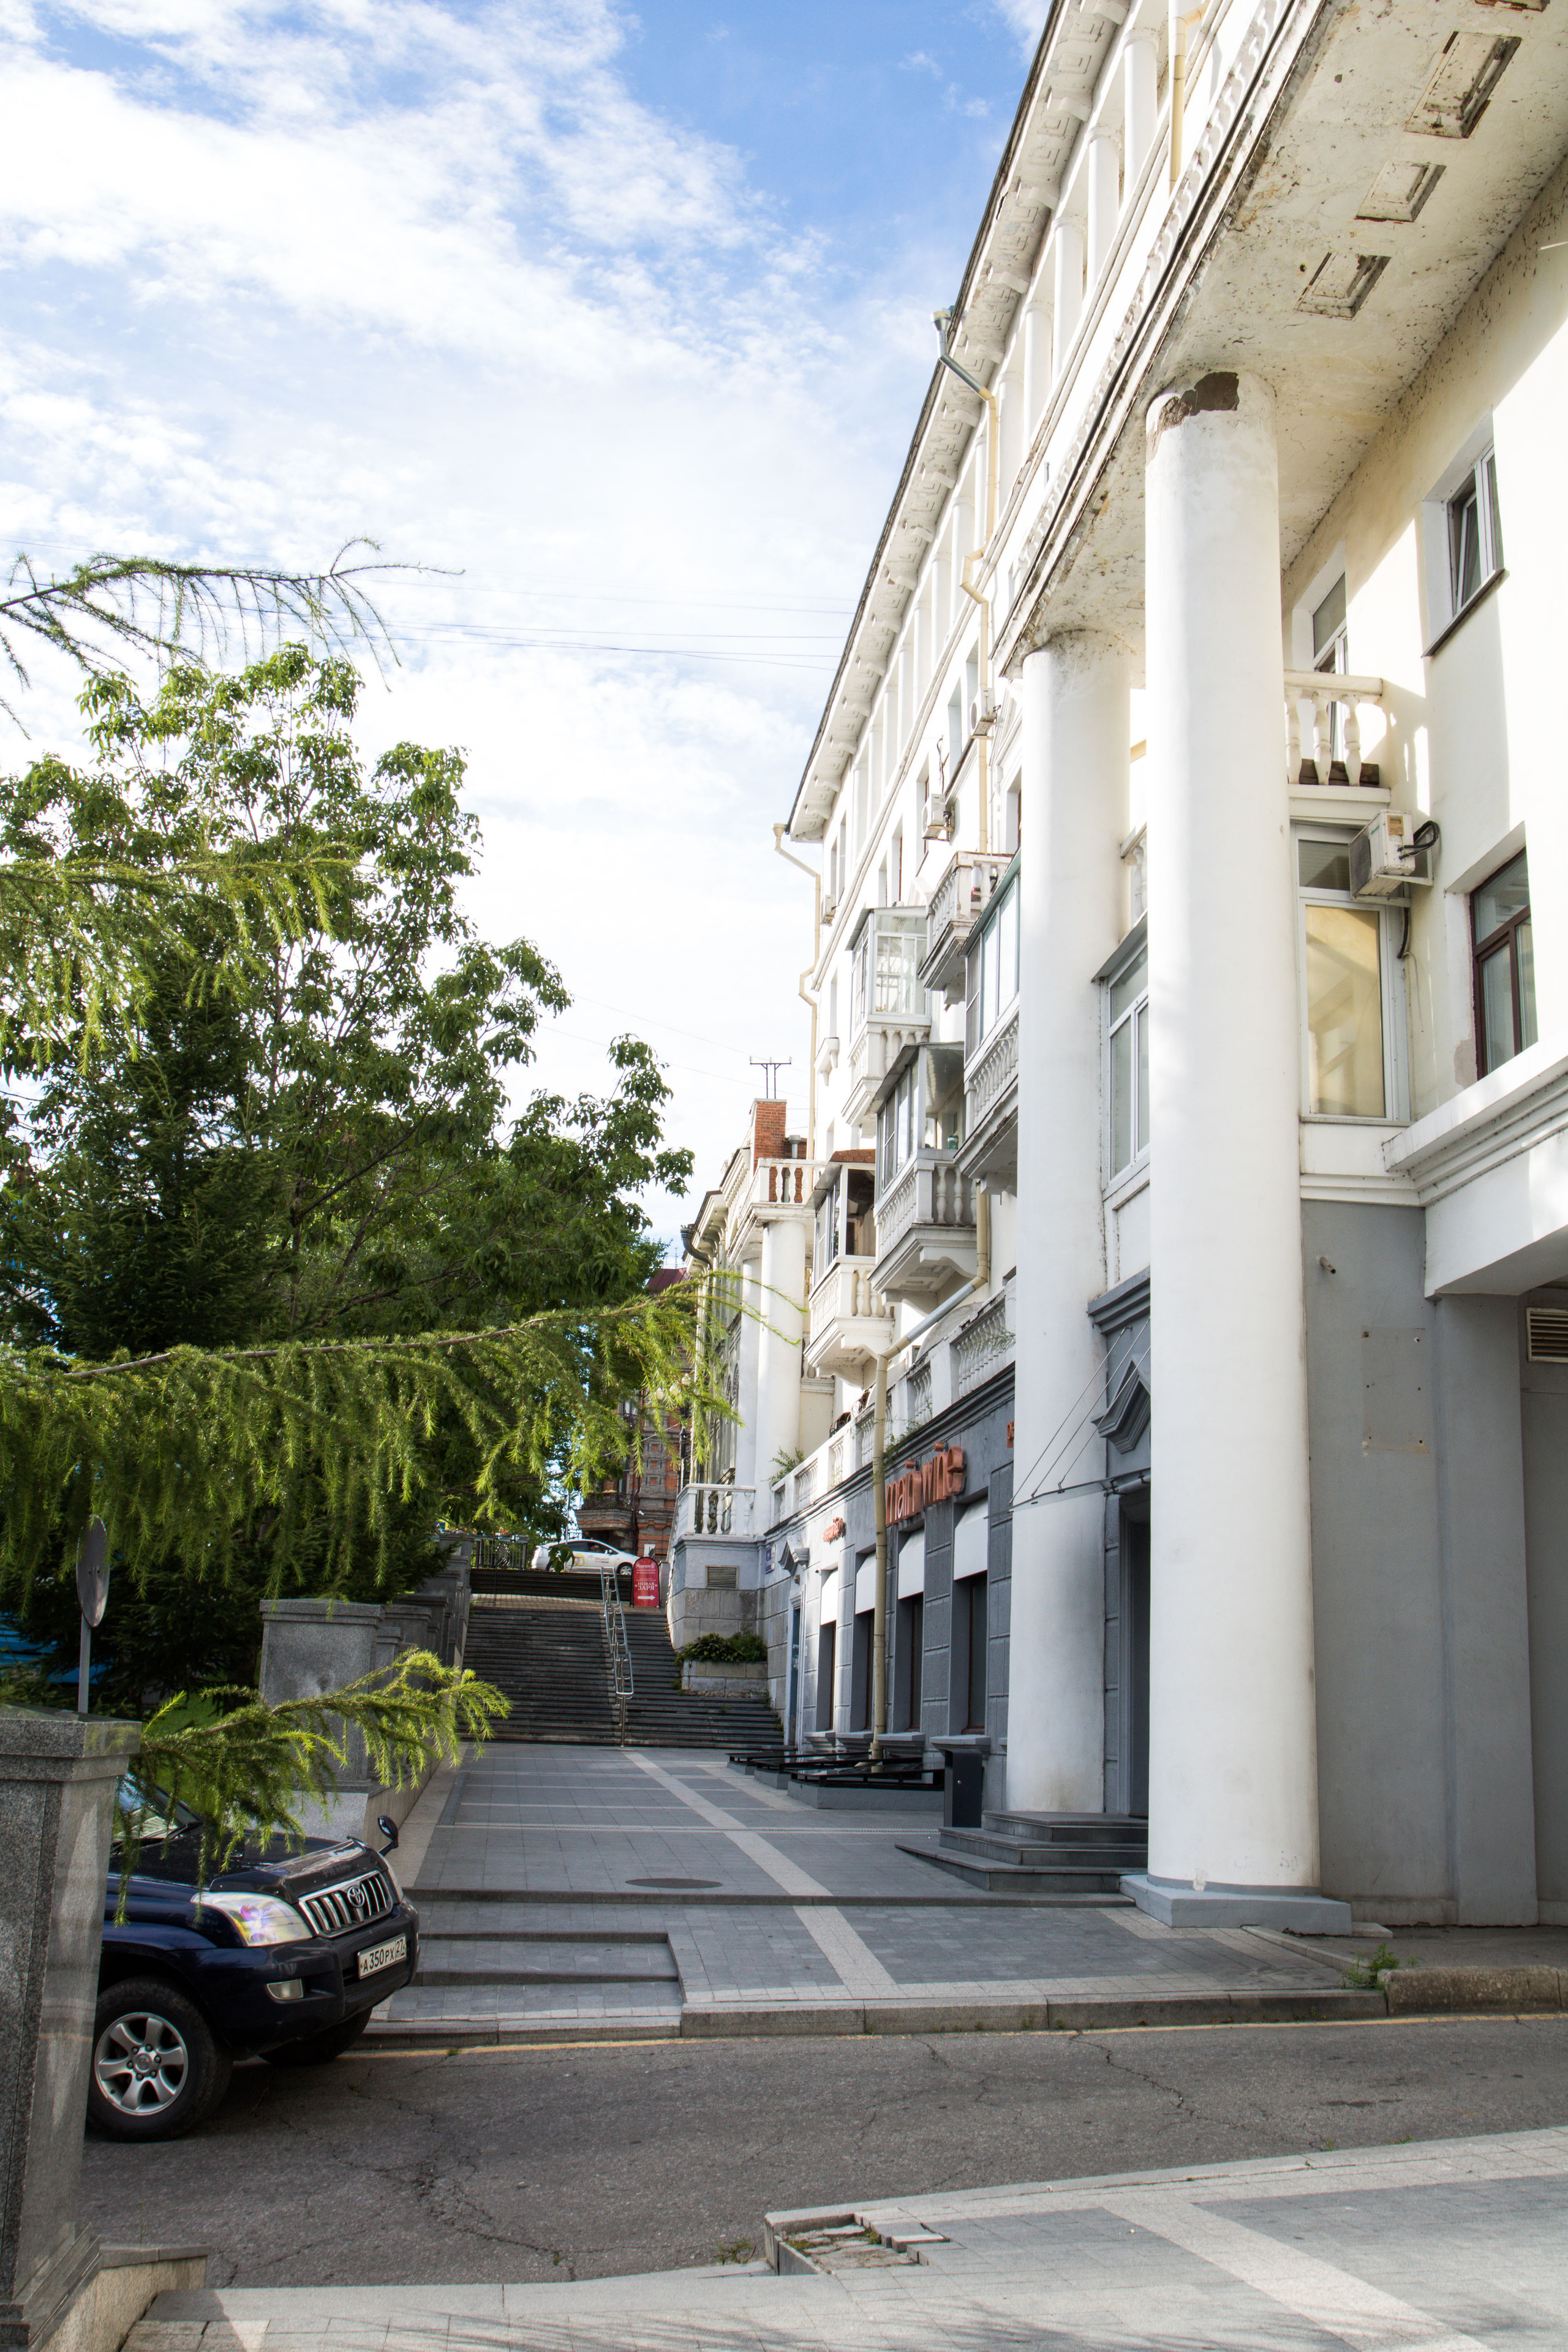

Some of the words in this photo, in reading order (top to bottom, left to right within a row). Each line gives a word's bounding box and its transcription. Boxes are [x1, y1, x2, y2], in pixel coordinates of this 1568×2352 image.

[886, 1460, 922, 1525] main
[922, 1441, 963, 1507] wine
[396, 1939, 404, 1953] 27
